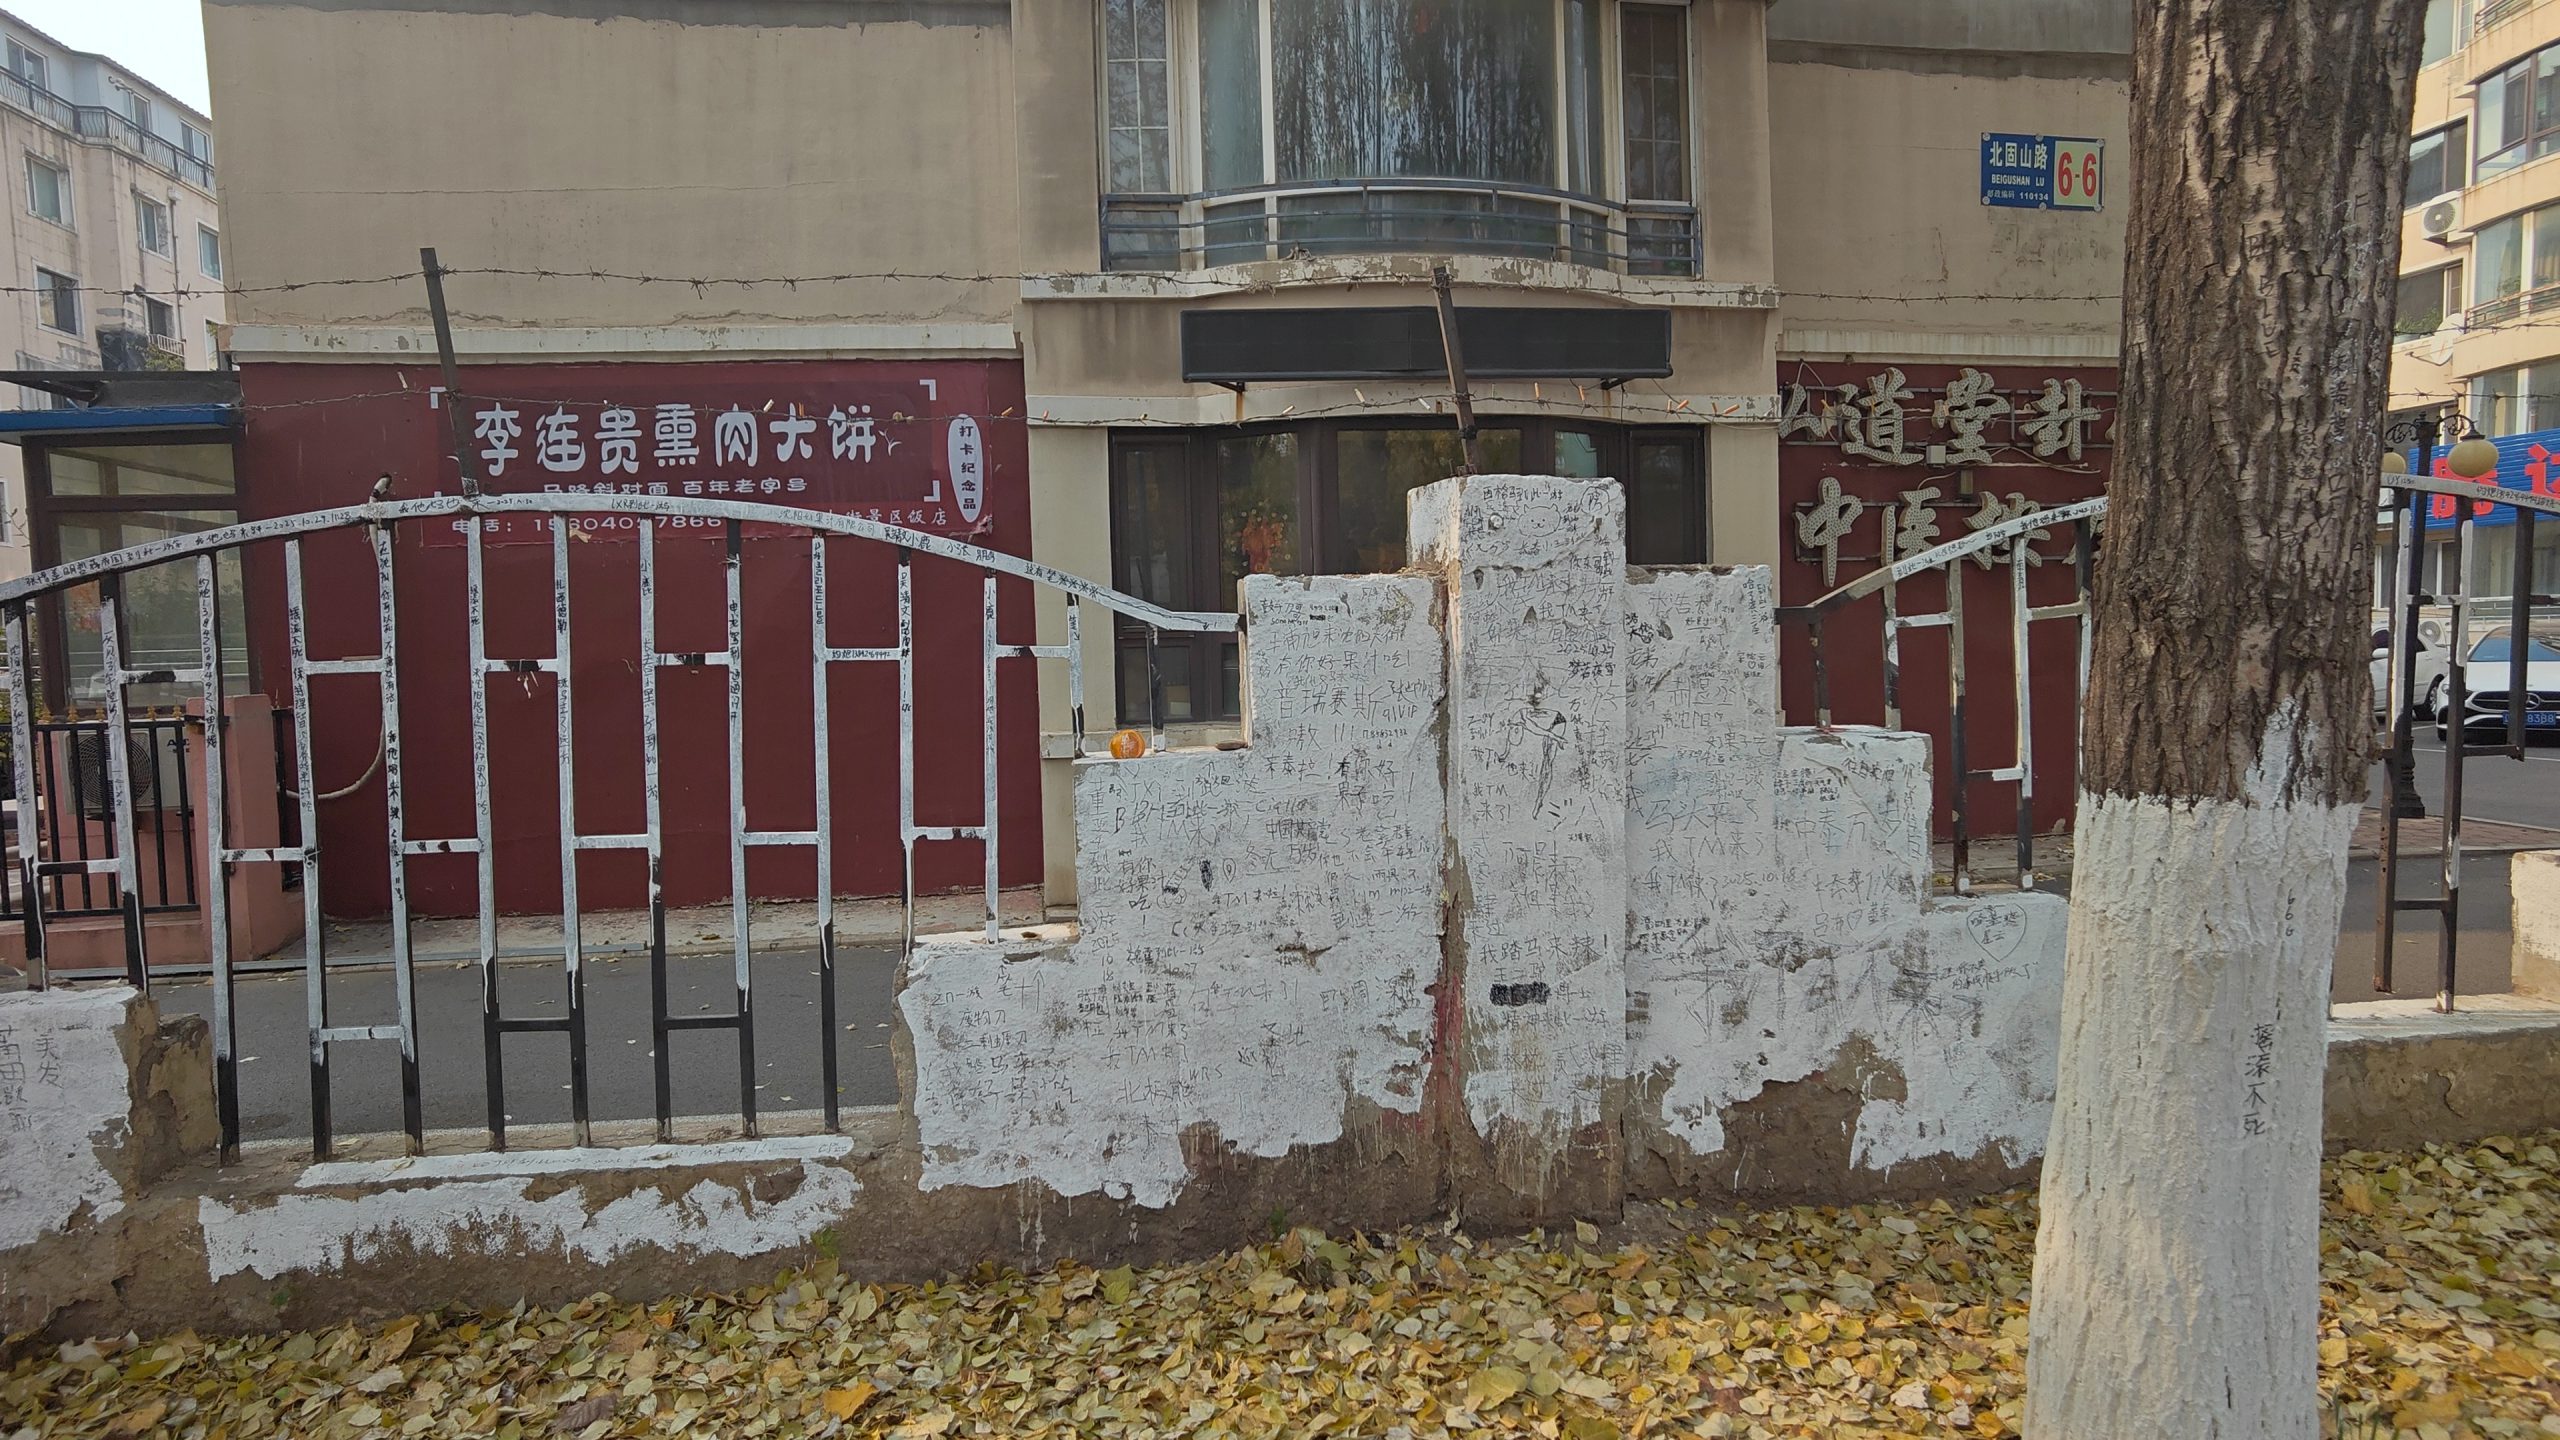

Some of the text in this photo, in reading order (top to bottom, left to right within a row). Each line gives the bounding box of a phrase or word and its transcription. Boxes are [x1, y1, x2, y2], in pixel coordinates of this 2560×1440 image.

[1990, 141, 2047, 170] 北固山路
[1991, 174, 2045, 187] BEIGUSHAN LU
[2058, 152, 2096, 196] 6-6
[2019, 192, 2049, 201] 110134
[474, 402, 877, 477] 李连贵熏肉大饼
[959, 425, 976, 510] 打卡纪念品
[683, 479, 808, 495] 百年老字号
